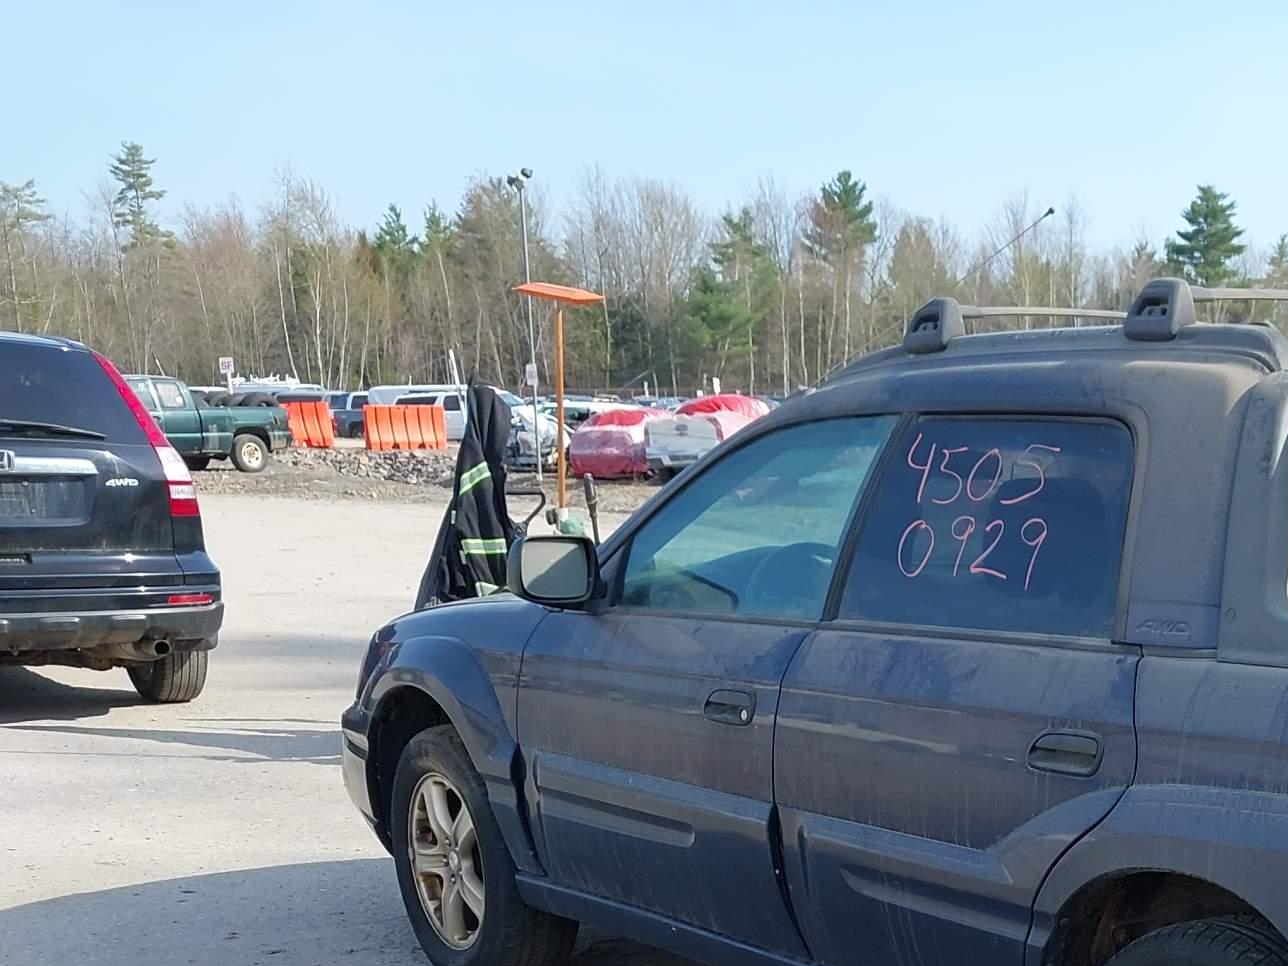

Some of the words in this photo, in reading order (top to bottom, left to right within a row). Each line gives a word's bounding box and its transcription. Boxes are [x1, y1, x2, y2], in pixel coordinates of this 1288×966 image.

[105, 478, 139, 487] 4WD
[908, 432, 1061, 504] 4505
[897, 515, 1048, 592] 0929
[1136, 619, 1190, 636] AWD
